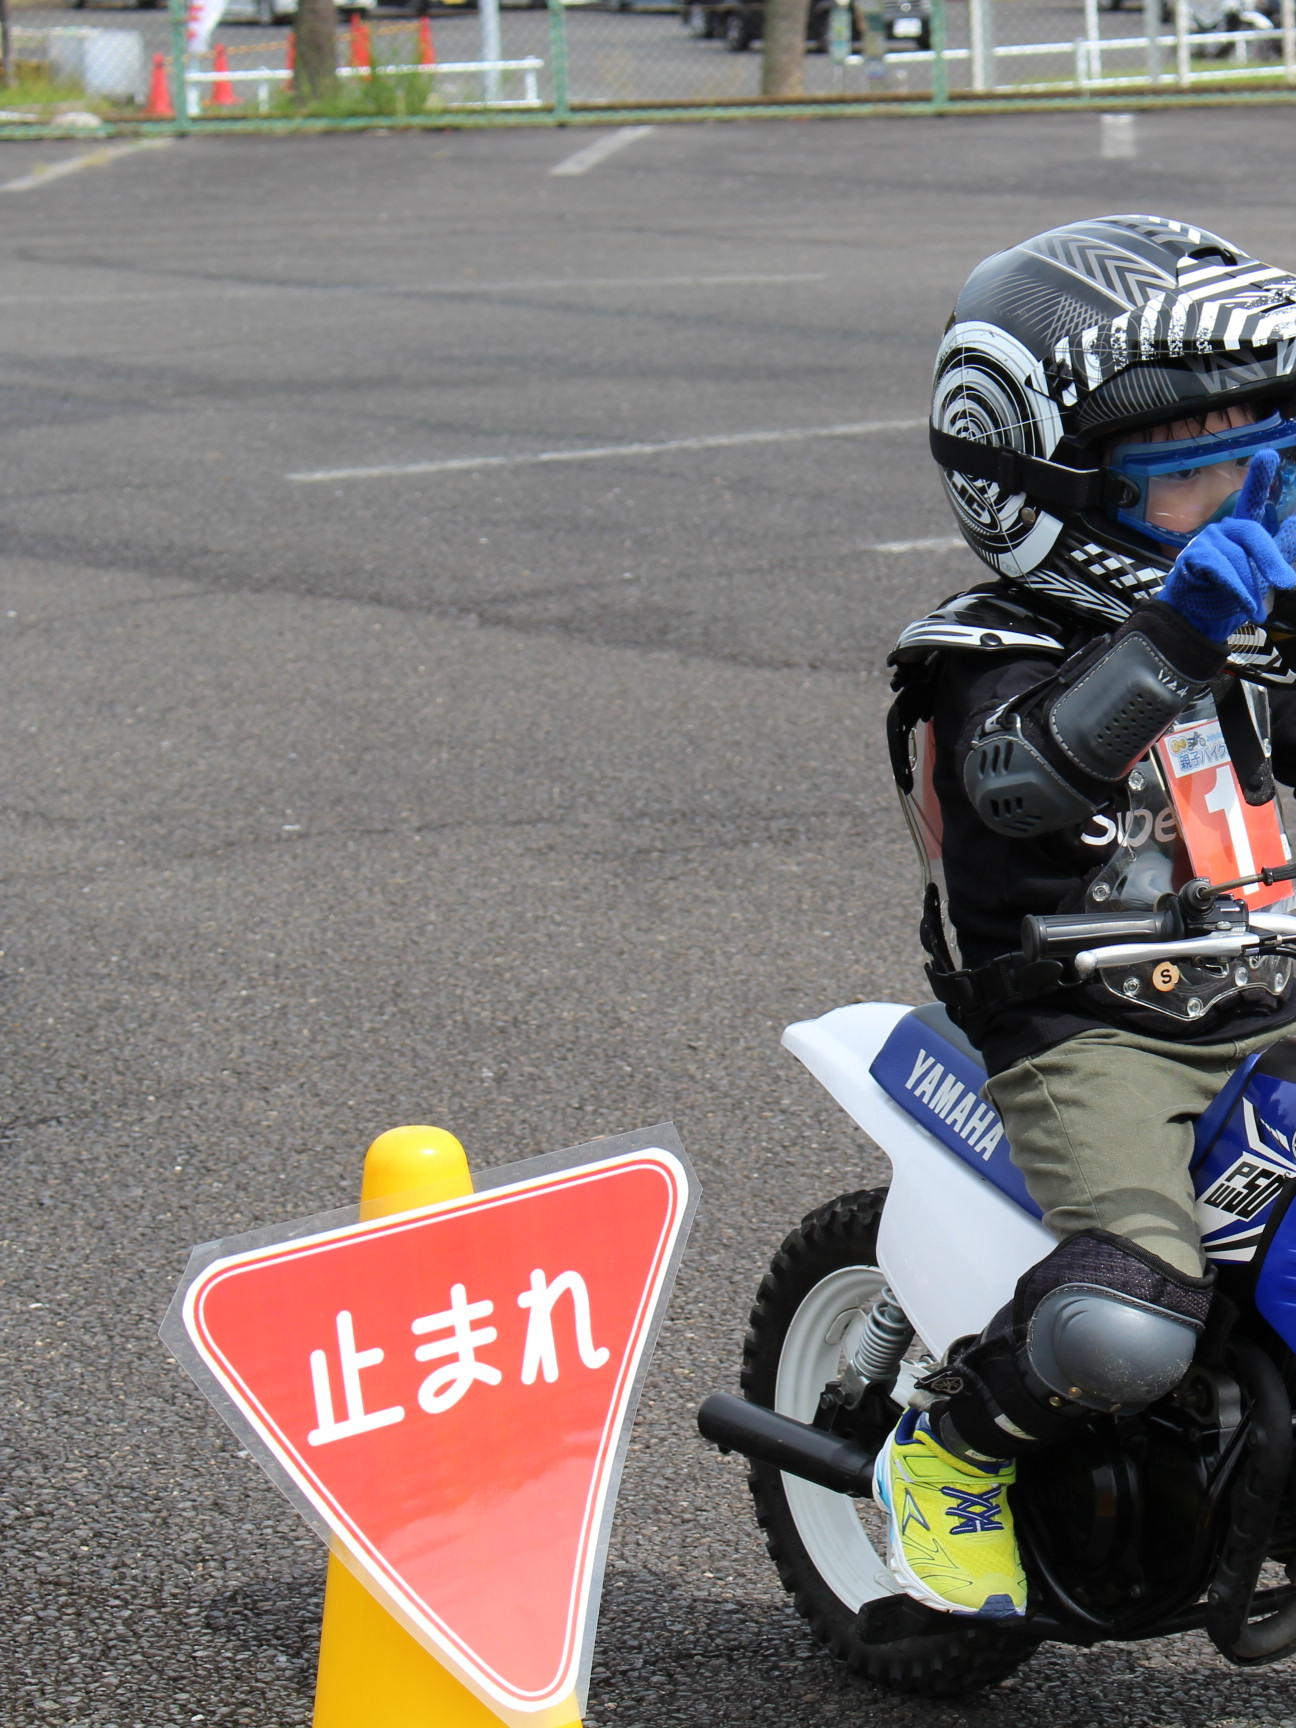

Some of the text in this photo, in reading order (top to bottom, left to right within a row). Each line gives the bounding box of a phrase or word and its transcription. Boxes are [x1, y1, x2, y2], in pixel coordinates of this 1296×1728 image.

[1204, 764, 1260, 895] 1
[1160, 968, 1172, 985] S
[904, 1048, 1005, 1162] YAMAHA
[306, 1267, 611, 1447] 止まれ
